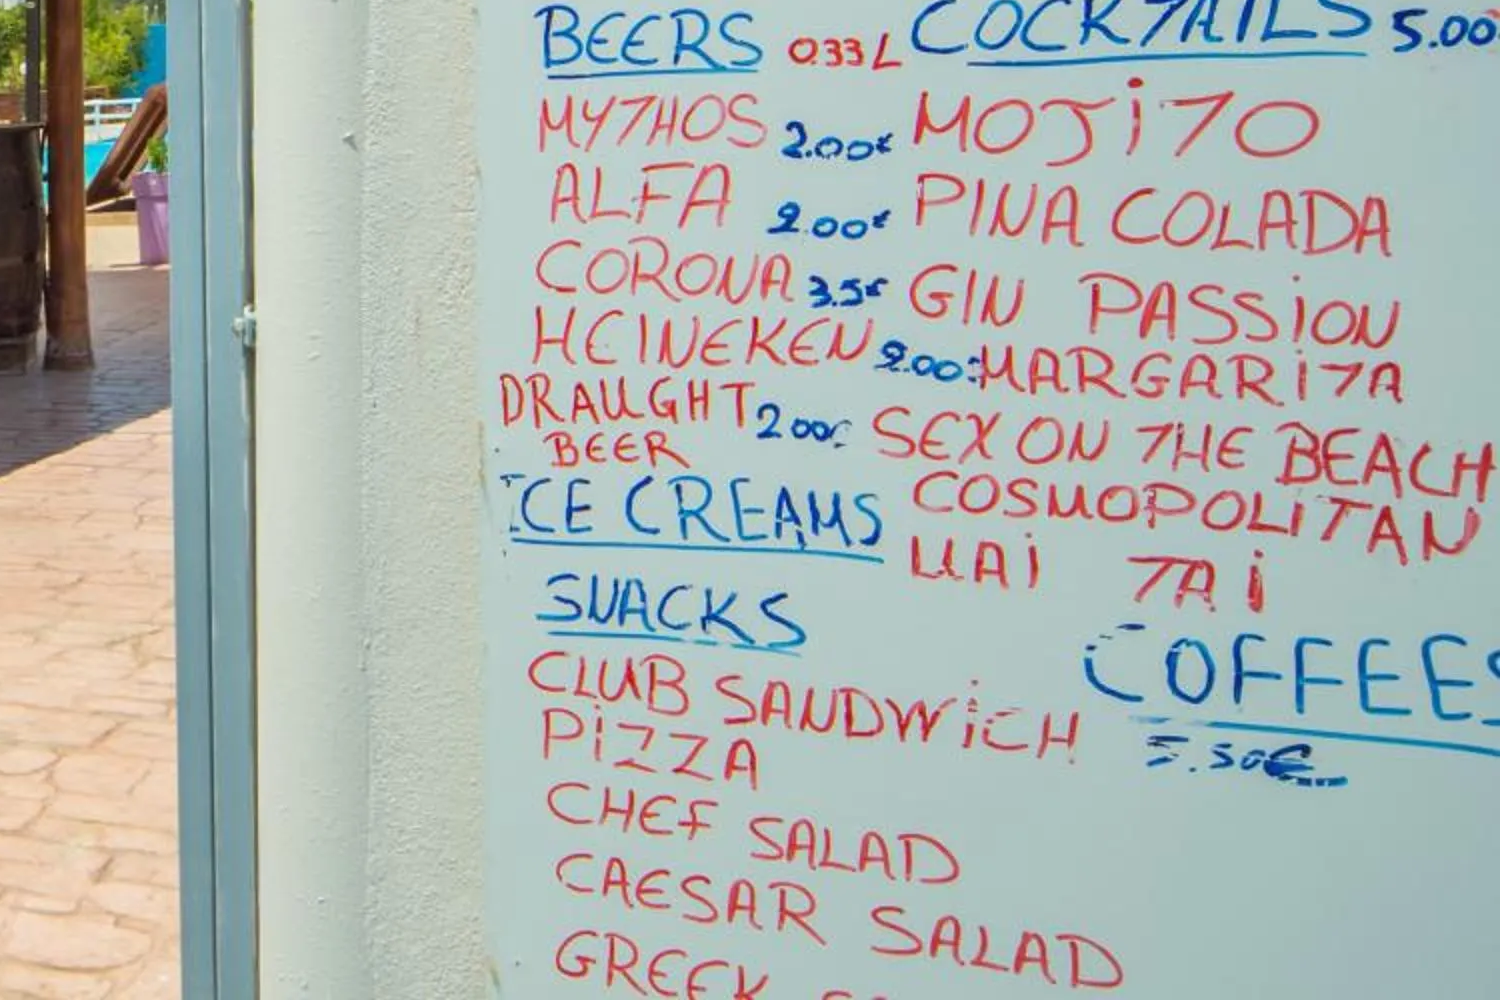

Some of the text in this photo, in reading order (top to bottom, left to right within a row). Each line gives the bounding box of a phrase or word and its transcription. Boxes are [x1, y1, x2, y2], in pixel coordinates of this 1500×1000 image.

[533, 3, 764, 68] BEERS
[538, 93, 767, 152] MYTHOS
[550, 161, 732, 229] ALFA
[915, 171, 1391, 256] PINA COLADA
[535, 236, 794, 305] CORONA
[907, 263, 1024, 327] GIN
[533, 305, 875, 369] HEINEKEN
[499, 372, 756, 429] DRAUGHT
[544, 430, 691, 469] BEER
[871, 406, 1496, 503] SEX ON THE BEACH
[623, 475, 884, 549] CREAMS
[911, 470, 1482, 567] COSMOPOLITAN
[535, 573, 807, 648] SNACKS
[527, 651, 691, 717] CLUB
[546, 782, 961, 885] CHEF SALAD
[555, 853, 1124, 989] CAESAR SALAD
